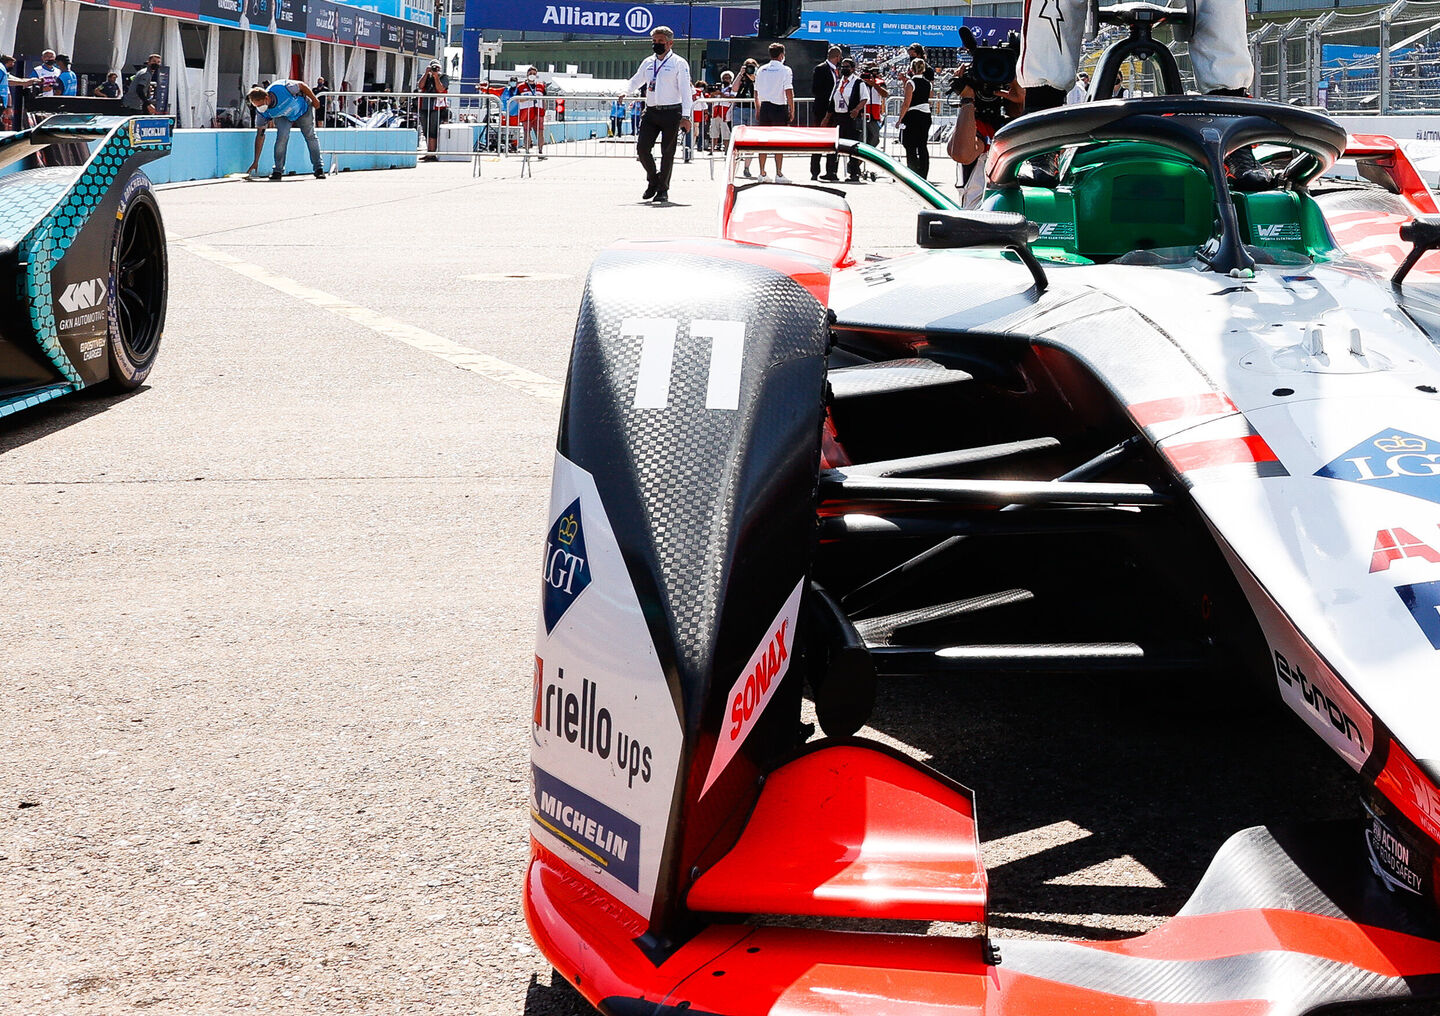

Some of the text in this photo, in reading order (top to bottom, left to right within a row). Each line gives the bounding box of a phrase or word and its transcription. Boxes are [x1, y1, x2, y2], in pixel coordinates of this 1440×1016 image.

[542, 5, 621, 27] Allianz
[839, 21, 870, 29] FORMULA
[1256, 224, 1284, 237] WE
[60, 310, 105, 331] GKN AUTOMOTIVE
[619, 317, 747, 411] 11
[728, 619, 790, 742] SONAX
[1273, 648, 1368, 755] e-tron
[545, 668, 653, 789] riello ups
[540, 789, 629, 863] MICHELIN
[1381, 829, 1410, 866] ACTION
[1395, 860, 1422, 891] SAFETY
